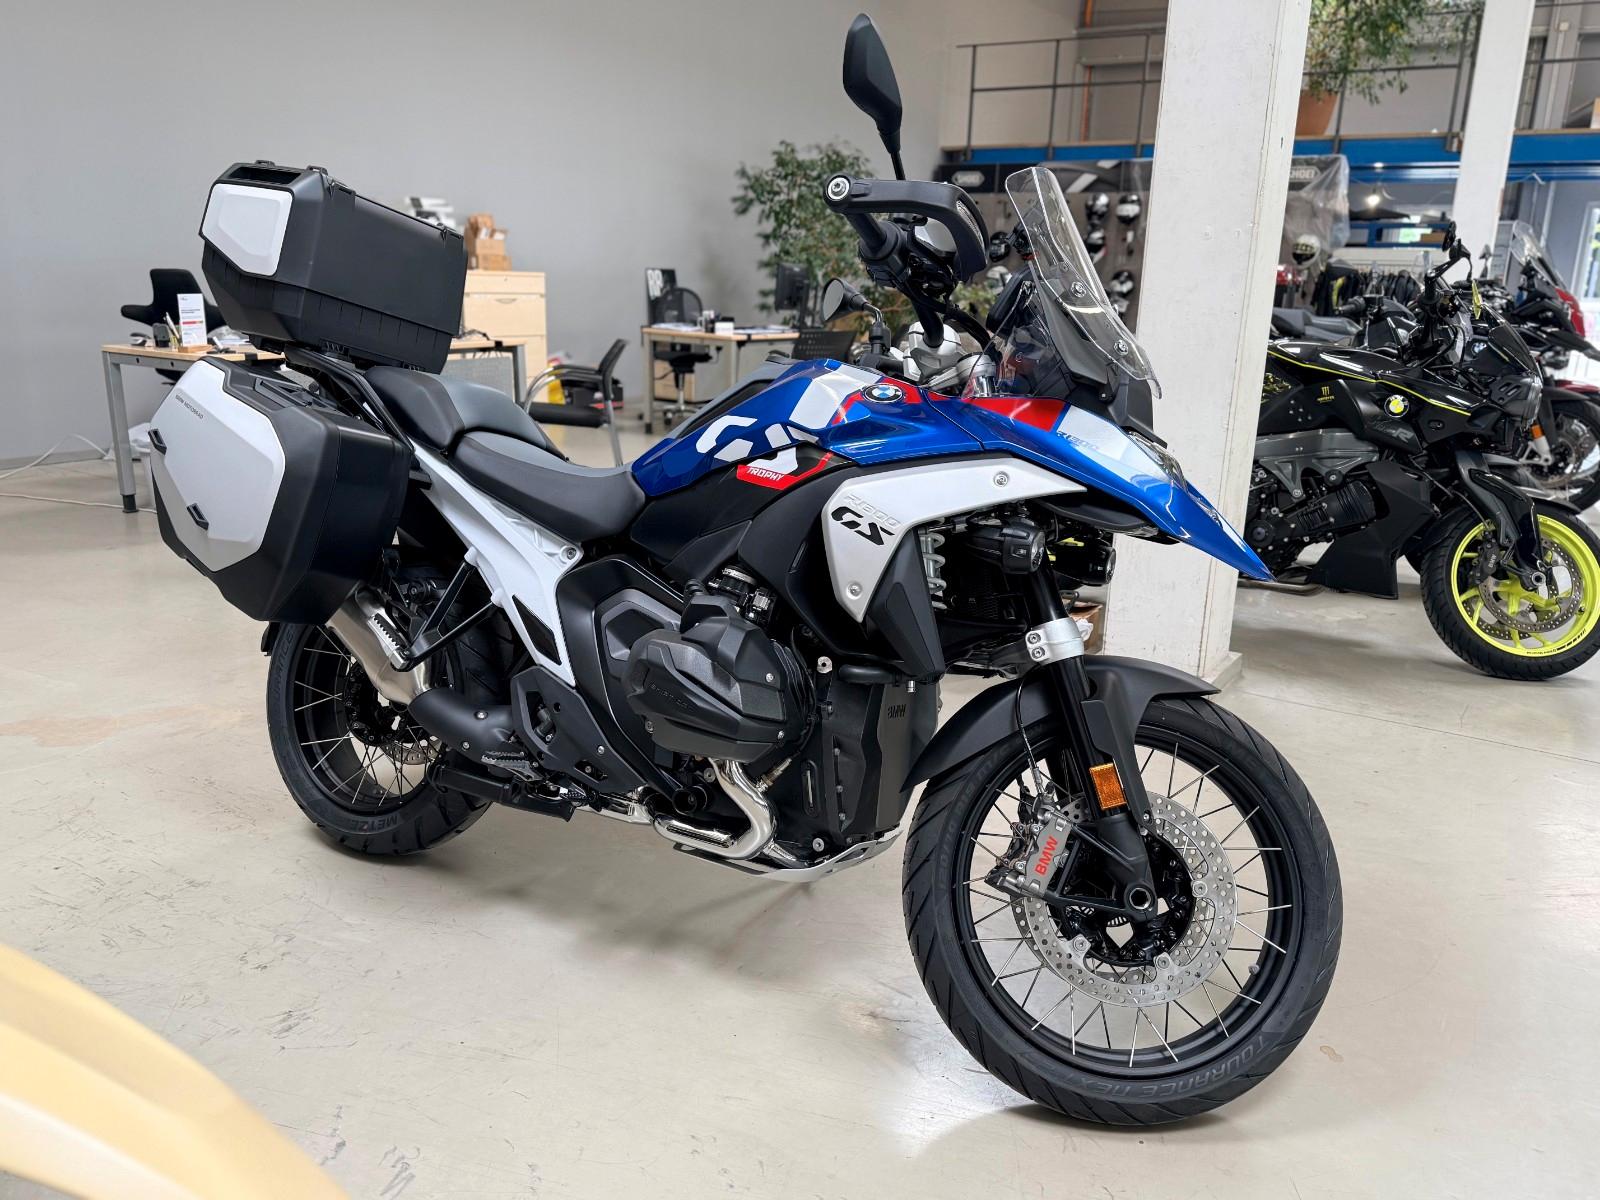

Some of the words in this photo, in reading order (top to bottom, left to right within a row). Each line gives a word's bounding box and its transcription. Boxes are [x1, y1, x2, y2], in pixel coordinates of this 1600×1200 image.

[746, 467, 785, 482] TROPHY
[830, 505, 896, 546] GS
[887, 703, 907, 719] BMW
[1033, 834, 1058, 877] BMW
[1142, 1035, 1268, 1094] TOURANCE
